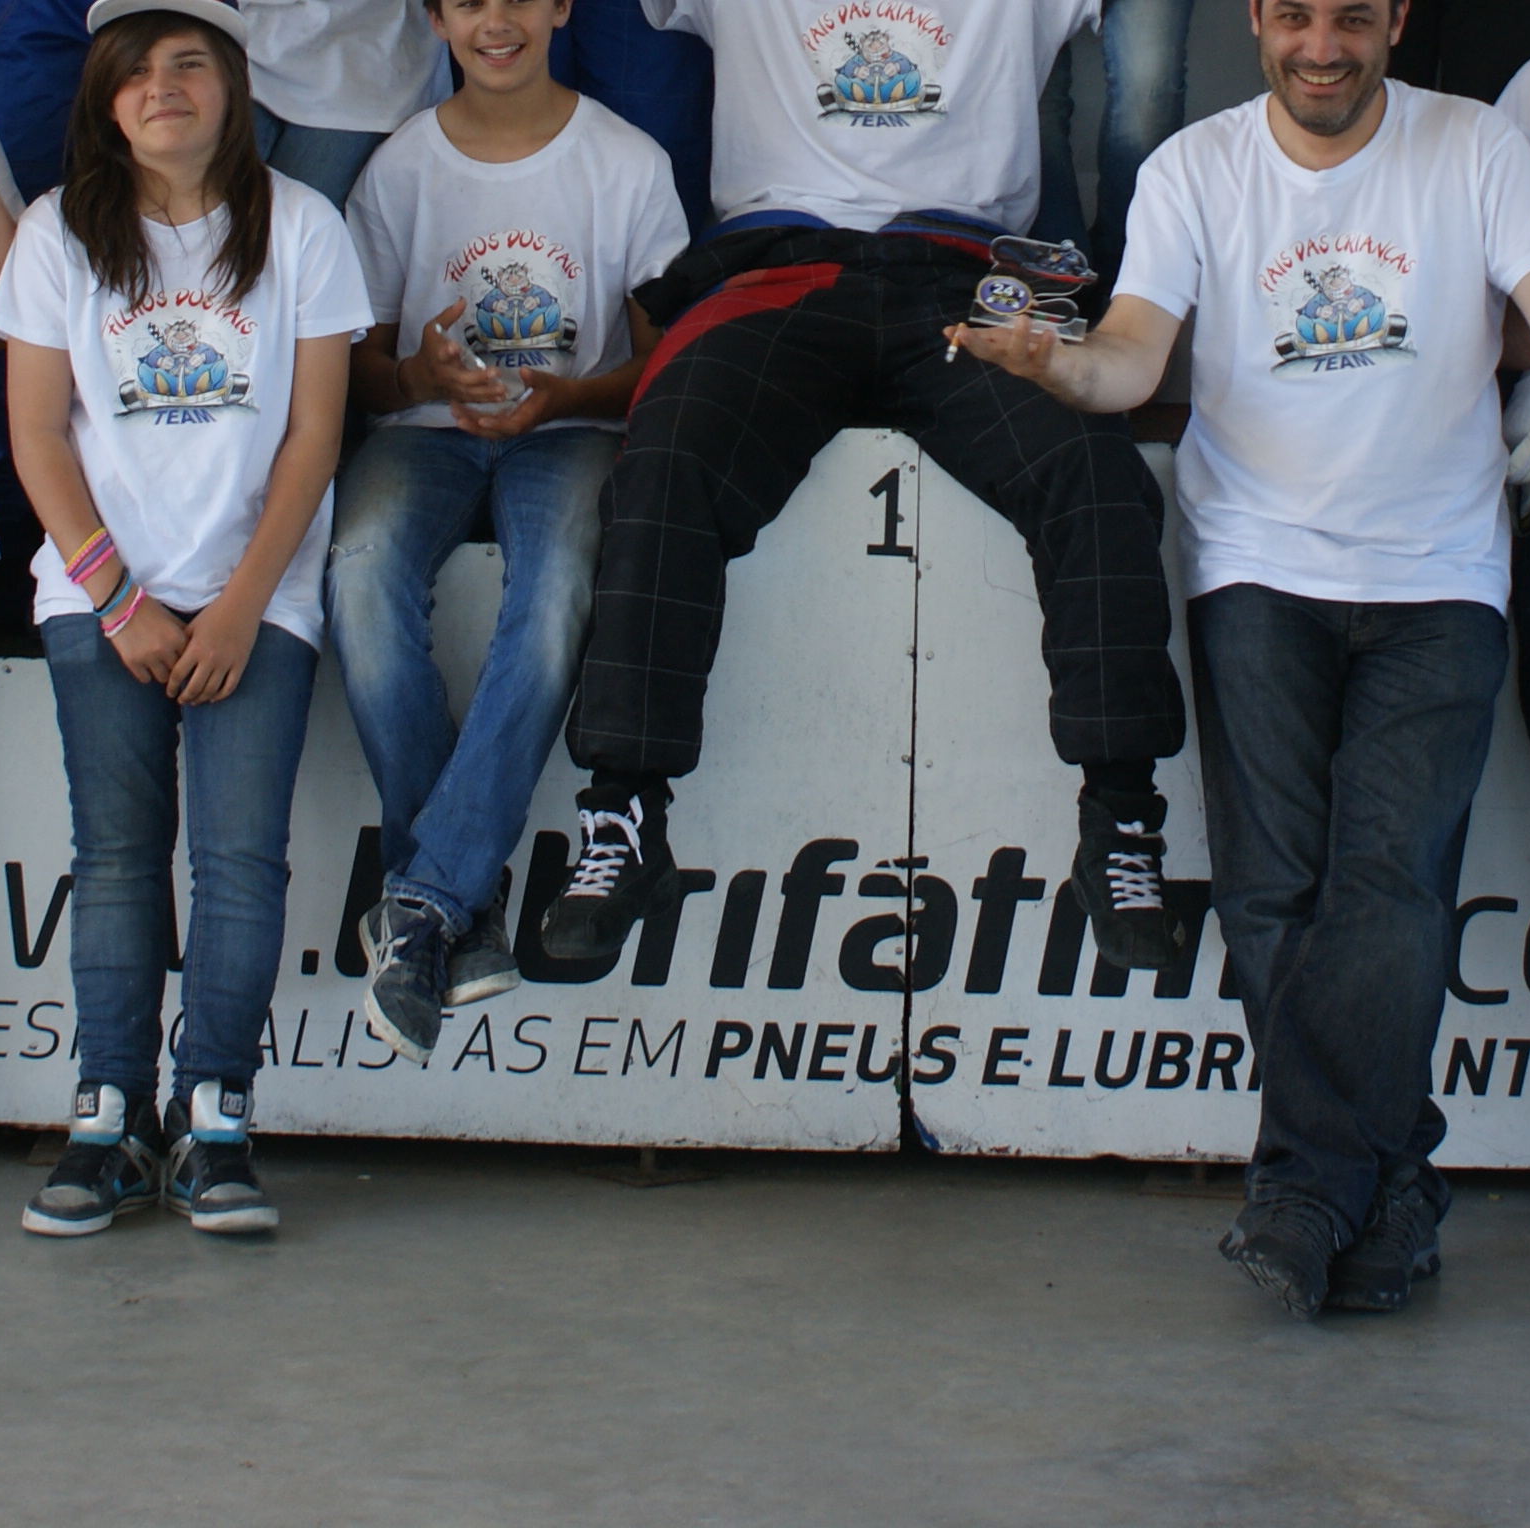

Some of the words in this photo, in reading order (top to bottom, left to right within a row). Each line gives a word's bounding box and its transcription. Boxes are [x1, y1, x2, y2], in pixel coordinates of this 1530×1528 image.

[801, 12, 835, 52] PAIS
[836, 0, 872, 25] DAS
[850, 112, 911, 128] TEAM
[503, 228, 548, 252] DOS
[545, 242, 585, 280] PAIS
[1258, 250, 1294, 293] PAIS
[1293, 234, 1330, 262] DAS
[494, 351, 552, 368] TEAM
[1312, 352, 1376, 373] TEAM
[154, 408, 217, 426] TEAM
[866, 466, 916, 560] 1
[574, 1017, 688, 1078] EM
[705, 1020, 961, 1087] PNEUS
[981, 1027, 1030, 1087] E
